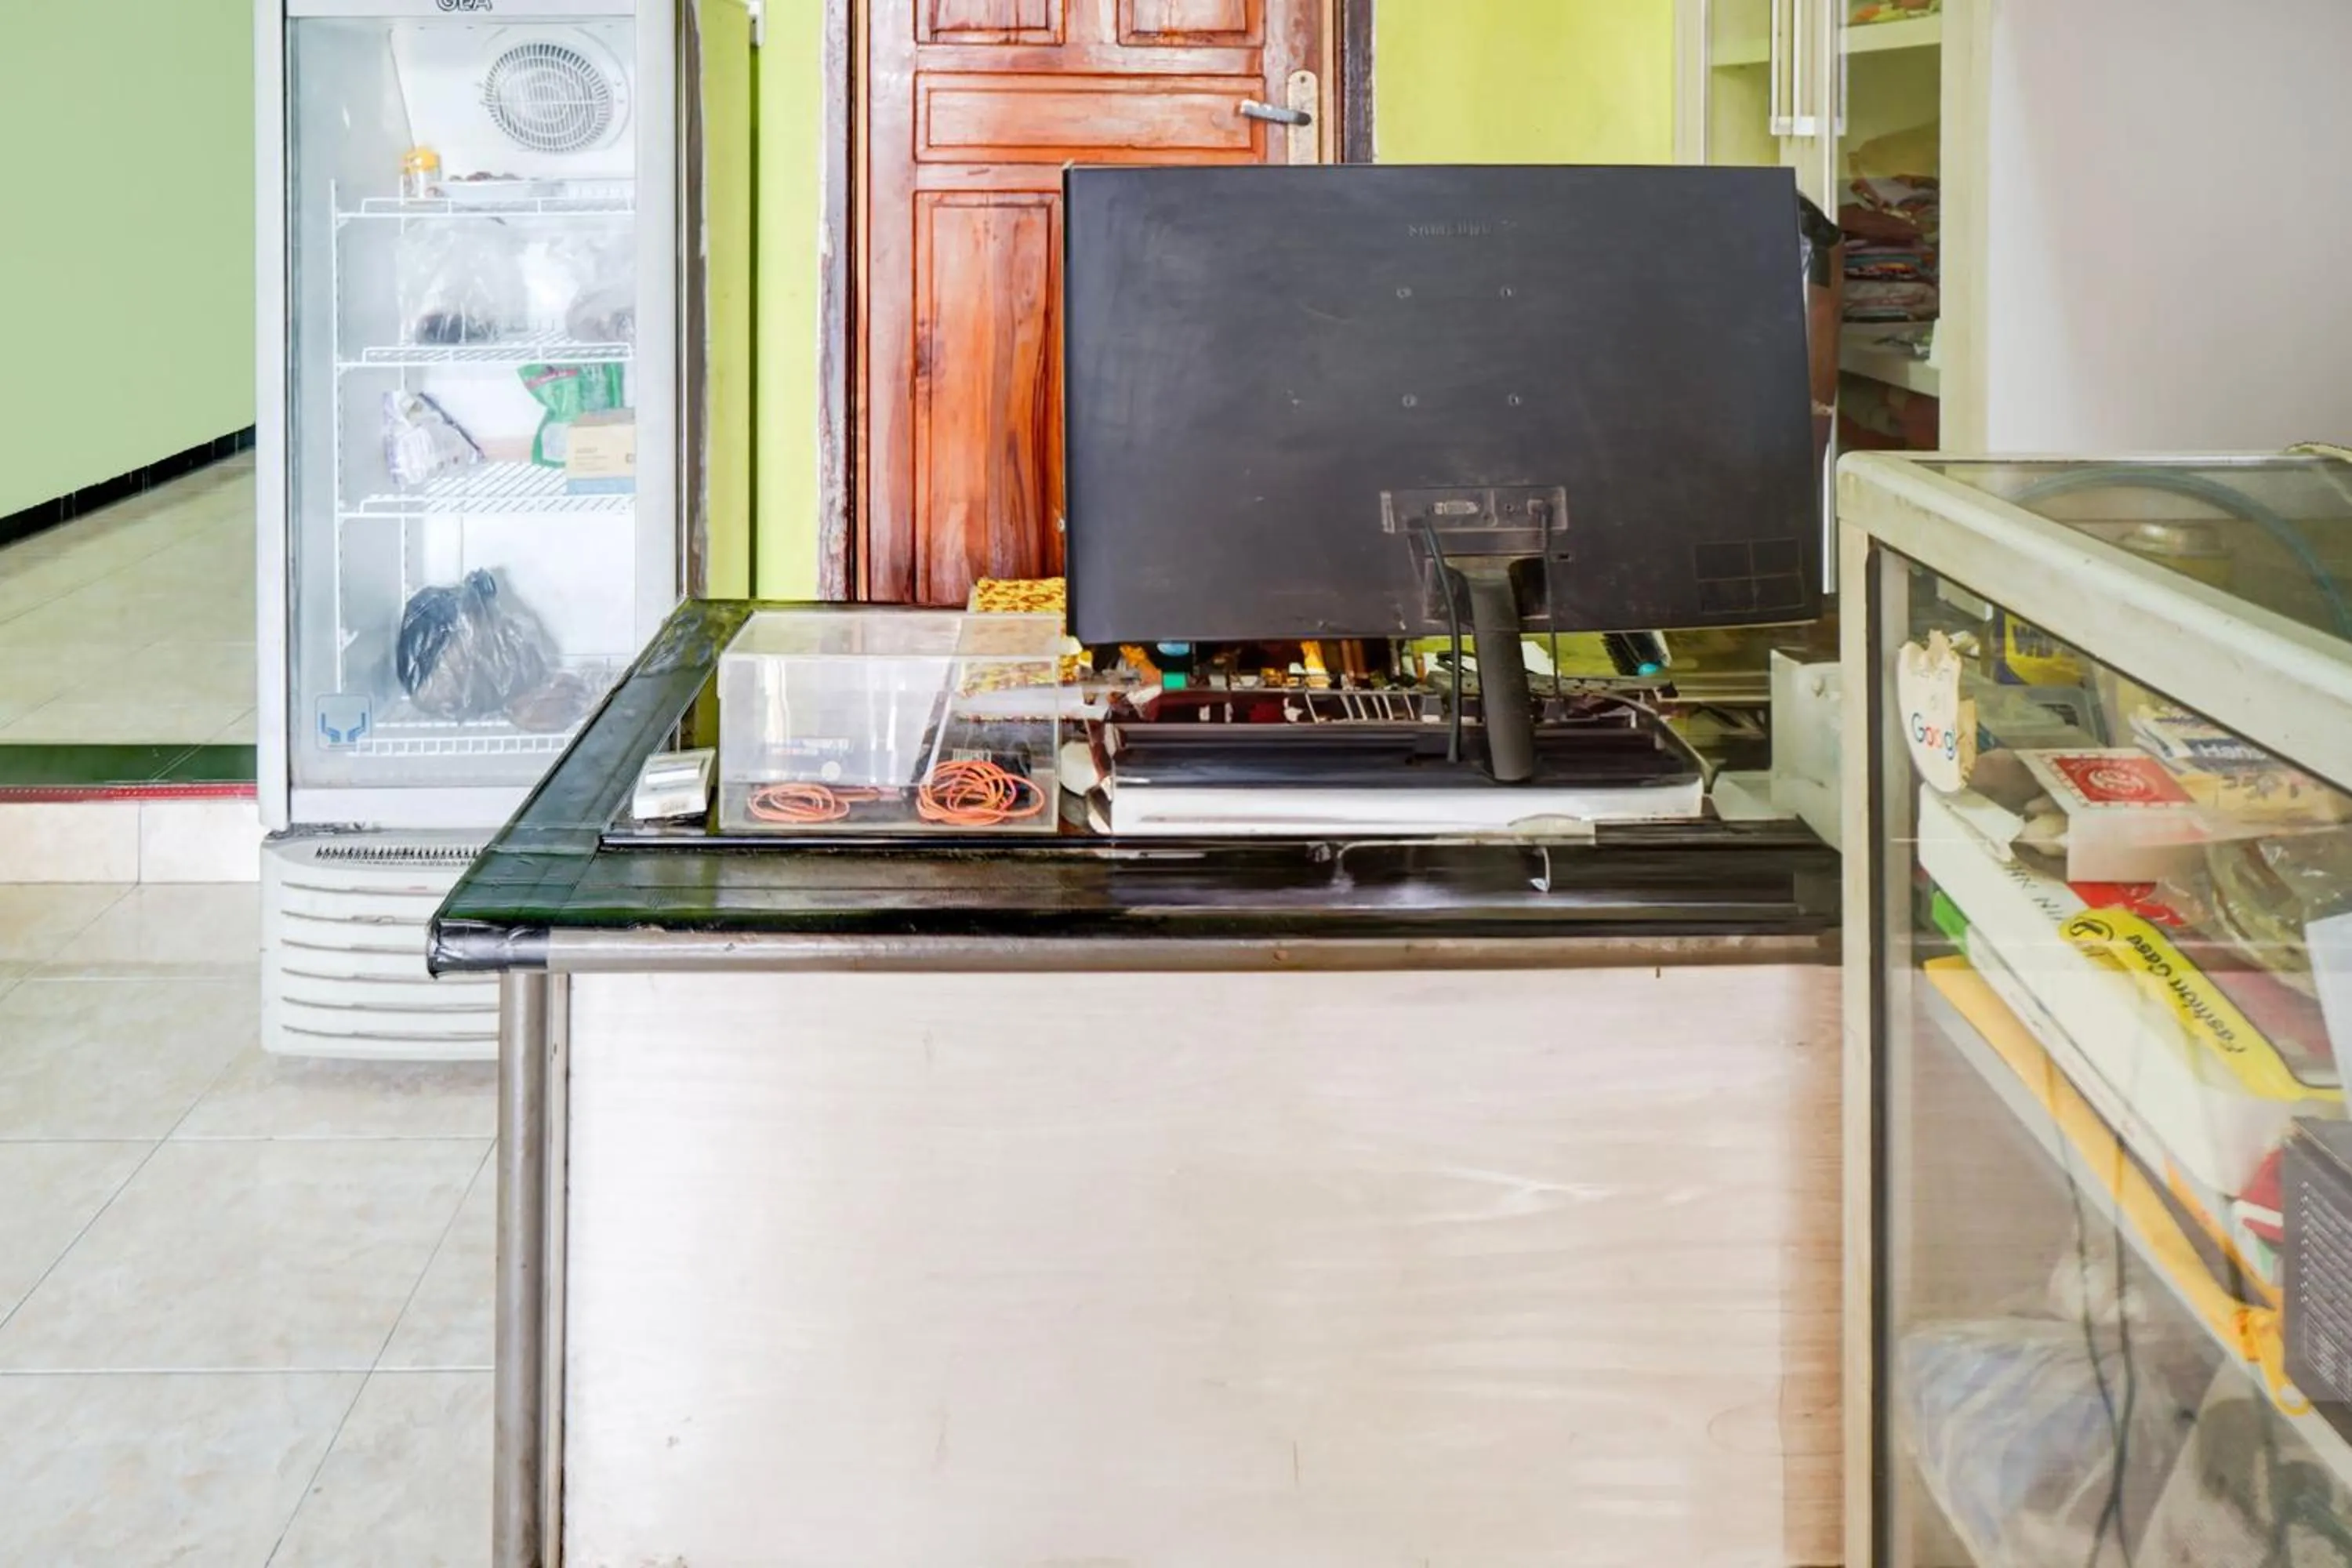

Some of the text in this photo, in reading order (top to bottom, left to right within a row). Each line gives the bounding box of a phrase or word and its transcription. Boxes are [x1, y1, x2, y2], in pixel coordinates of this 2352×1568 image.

[1911, 712, 1958, 760] Goog
[2125, 933, 2248, 1054] Fashion Case
